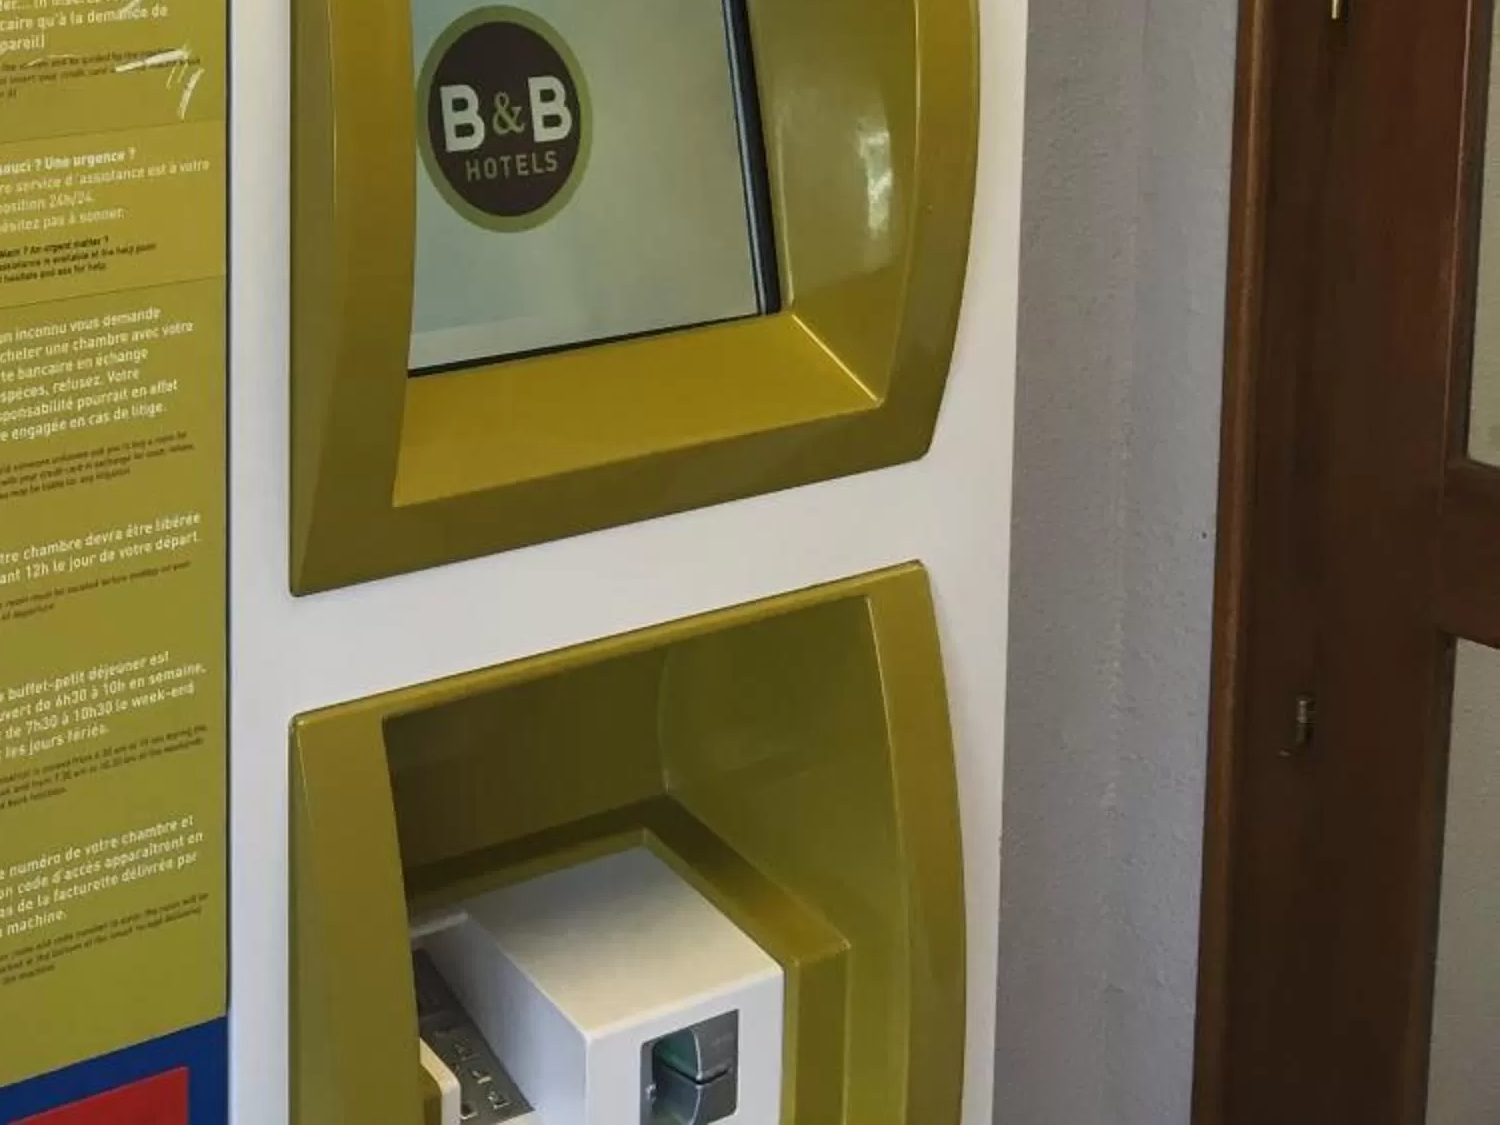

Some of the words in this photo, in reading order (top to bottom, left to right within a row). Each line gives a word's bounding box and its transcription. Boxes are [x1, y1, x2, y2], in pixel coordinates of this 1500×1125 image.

[38, 12, 66, 28] qu'à
[71, 11, 82, 24] la
[88, 6, 147, 23] demande
[151, 4, 168, 17] de
[16, 177, 61, 192] service
[148, 164, 168, 176] est
[180, 160, 209, 172] votre
[45, 156, 69, 169] Une
[73, 152, 125, 168] urgence
[465, 151, 559, 181] HOTELS
[16, 324, 67, 341] inconnu
[70, 318, 100, 332] vous
[103, 307, 161, 326] demande
[46, 343, 68, 355] une
[73, 332, 128, 351] chambre
[132, 328, 158, 342] avec
[162, 322, 194, 337] votre
[18, 361, 72, 380] bancaire
[77, 359, 92, 370] en
[96, 348, 148, 367] échange
[108, 369, 140, 383] Votre
[77, 388, 128, 411] pourrait
[131, 386, 147, 399] en
[150, 379, 177, 396] effet
[11, 420, 67, 440] engagée
[70, 417, 85, 428] en
[88, 411, 110, 425] cas
[113, 407, 129, 420] de
[23, 538, 83, 558] chambre
[85, 530, 122, 546] devra
[126, 523, 152, 538] être
[26, 563, 49, 579] 12h
[52, 561, 65, 573] le
[69, 554, 96, 572] jour
[99, 550, 115, 563] de
[119, 542, 152, 558] votre
[88, 657, 146, 681] déjeuner
[149, 651, 169, 666] est
[6, 725, 21, 738] de
[26, 714, 57, 733] 7h30
[73, 702, 113, 722] 10h30
[116, 698, 128, 712] le
[131, 682, 195, 707] week-end
[36, 700, 51, 713] de
[103, 680, 126, 695] 10h
[129, 678, 145, 690] en
[9, 854, 61, 877] numéro
[65, 847, 81, 862] de
[84, 838, 118, 855] votre
[122, 820, 177, 844] chambre
[180, 815, 194, 828] et
[18, 875, 48, 894] code
[188, 833, 203, 844] en
[18, 899, 33, 912] de
[37, 893, 49, 908] la
[53, 874, 119, 902] facturette
[122, 858, 173, 882] délivrée
[178, 851, 197, 870] par
